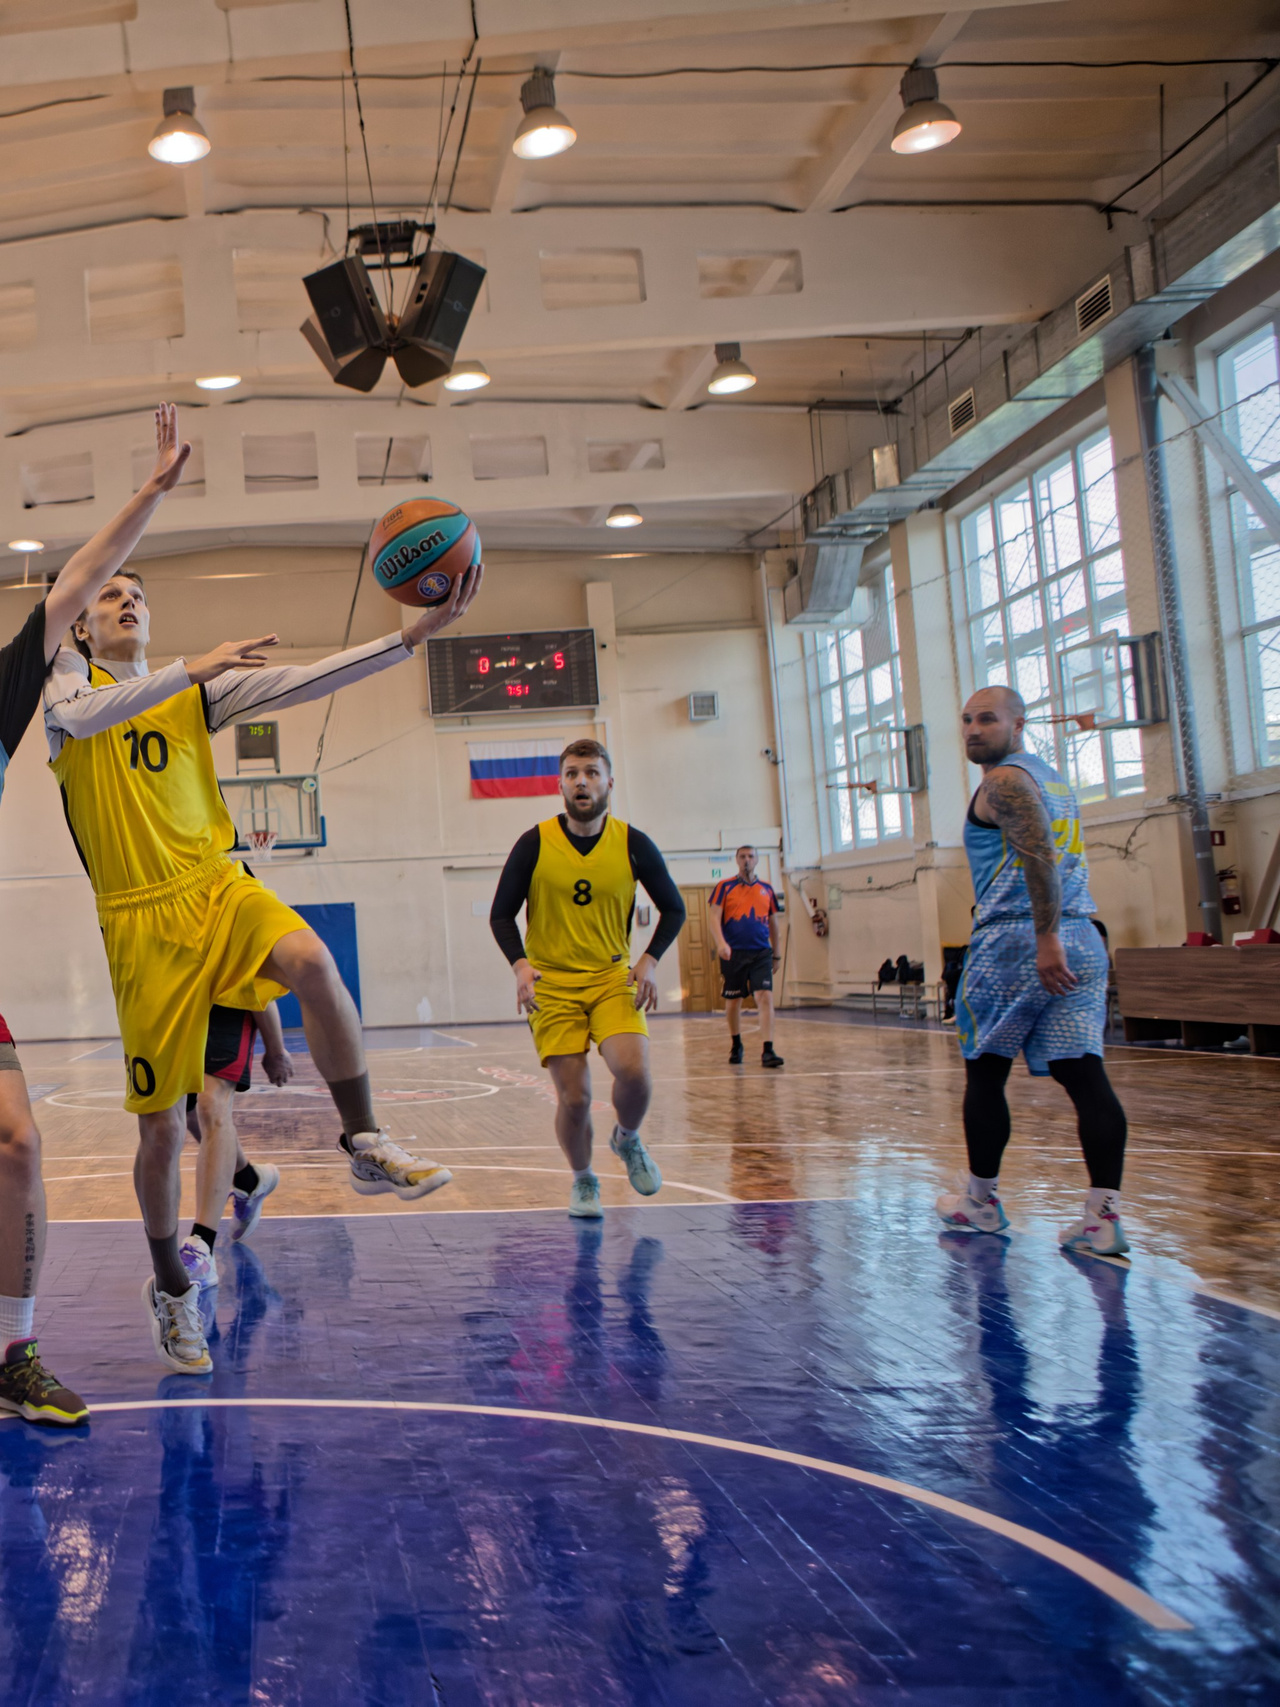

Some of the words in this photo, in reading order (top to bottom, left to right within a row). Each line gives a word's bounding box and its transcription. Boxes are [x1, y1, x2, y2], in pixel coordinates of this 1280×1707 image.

[378, 529, 447, 581] Wilson
[479, 657, 490, 673] 0
[554, 652, 565, 669] 5
[507, 685, 529, 696] 7:51
[249, 725, 270, 736] 7:51
[123, 729, 169, 772] 10
[573, 880, 592, 906] 8
